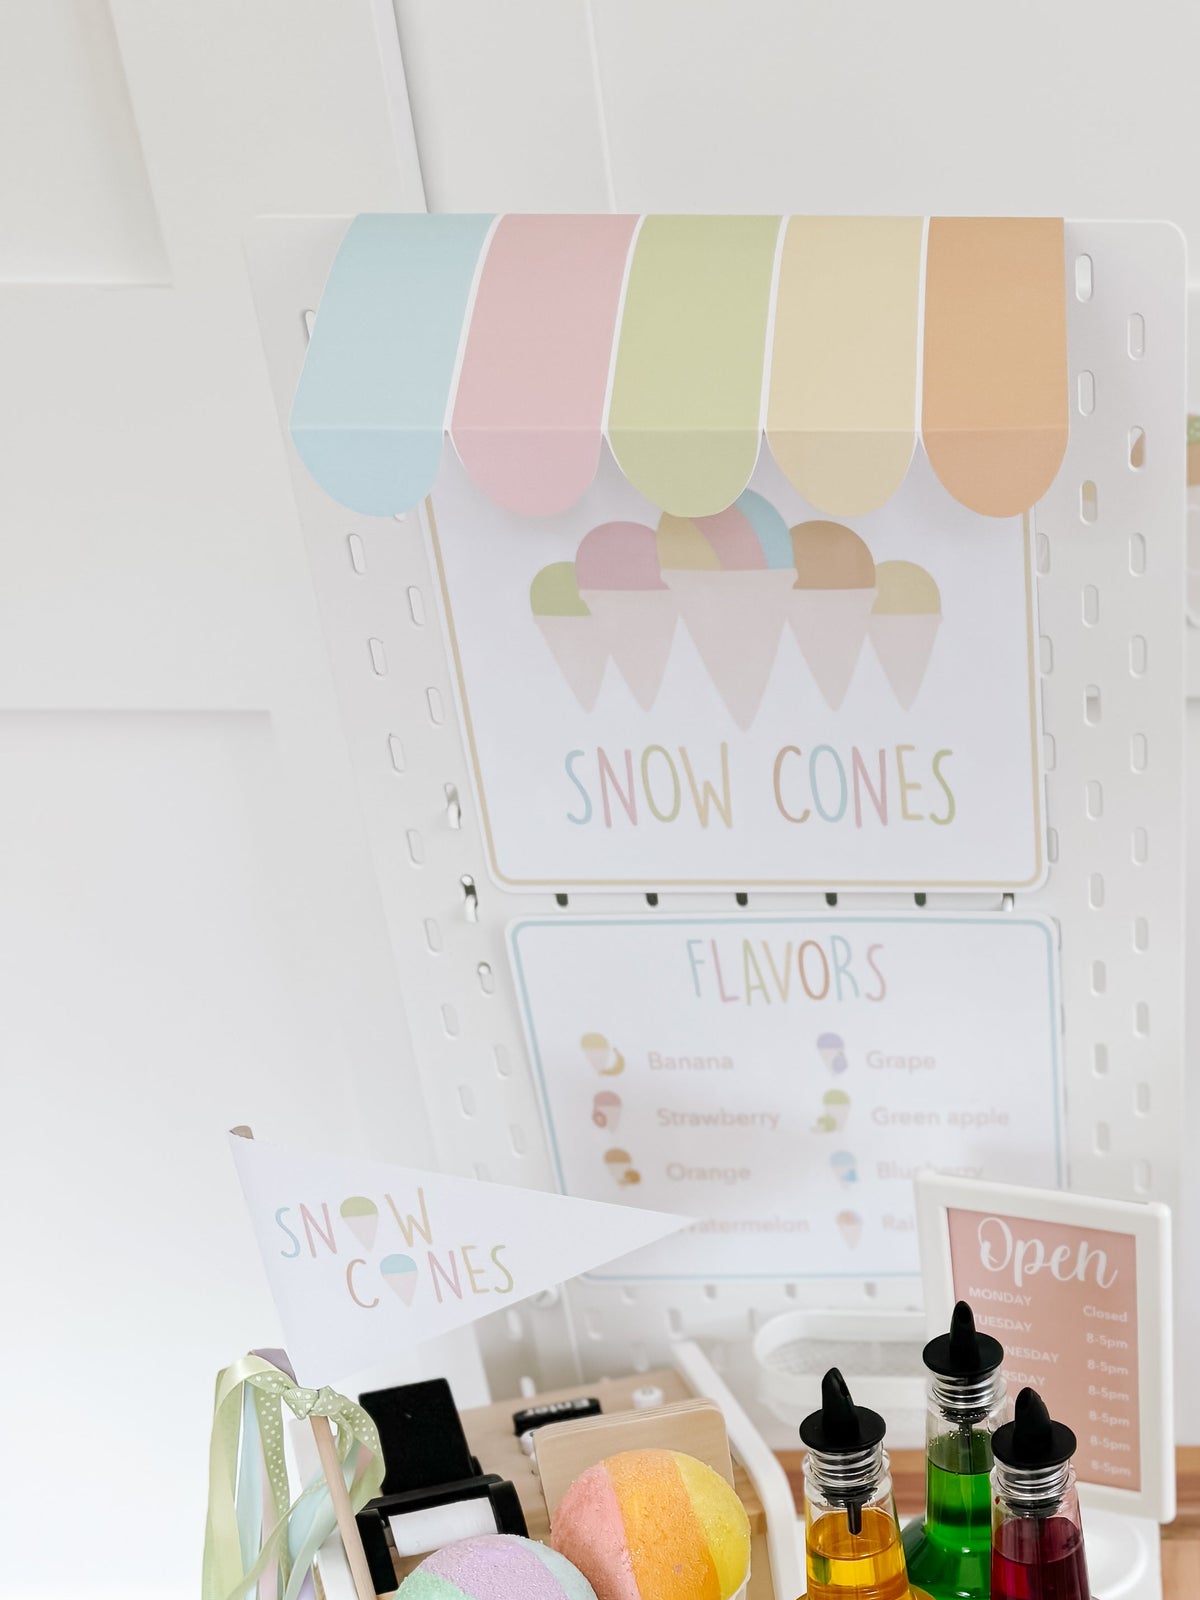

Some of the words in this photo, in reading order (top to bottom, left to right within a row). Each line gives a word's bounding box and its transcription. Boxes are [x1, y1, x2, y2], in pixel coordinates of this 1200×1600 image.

[564, 741, 734, 830] SNOW
[772, 744, 957, 830] CONES
[685, 934, 888, 1007] FLAVORS
[648, 1051, 735, 1072] Banana
[866, 1050, 937, 1075] Grape
[656, 1106, 782, 1132] Strawberry
[871, 1105, 941, 1127] Green
[947, 1106, 1011, 1130] apple
[665, 1162, 752, 1186] Orange
[977, 1216, 1120, 1290] Open
[968, 1286, 1033, 1307] MONDAY
[1082, 1304, 1129, 1324] Closed
[1086, 1332, 1129, 1351] 8-5pm
[1087, 1359, 1130, 1377] 8-5pm
[1088, 1384, 1130, 1403] 8-5pm
[1089, 1410, 1131, 1429] 8-5pm
[1090, 1435, 1131, 1453] 8-5pm
[1091, 1459, 1132, 1477] 8-5pm
